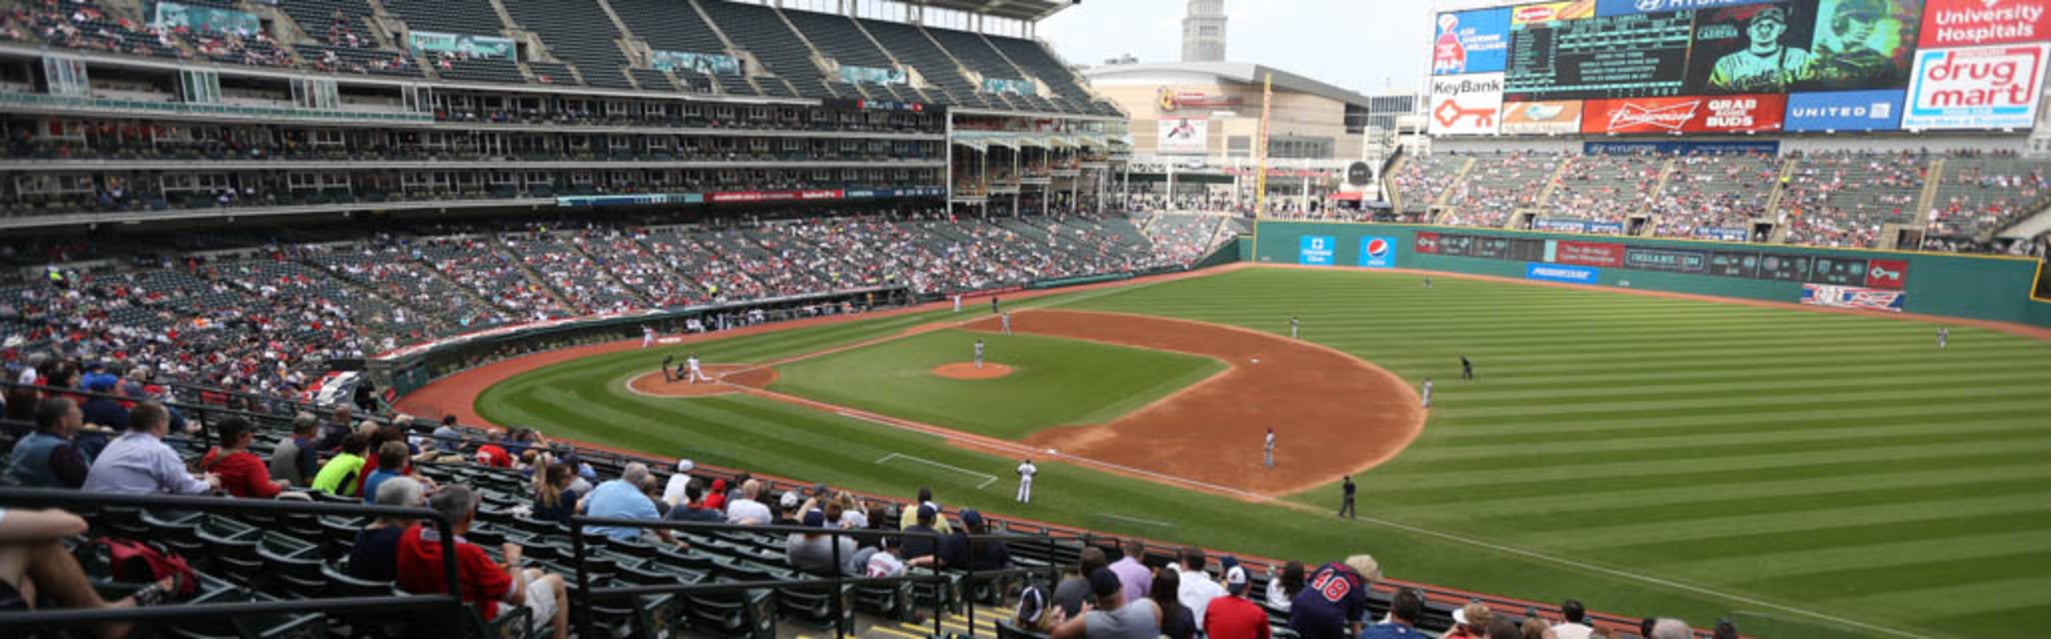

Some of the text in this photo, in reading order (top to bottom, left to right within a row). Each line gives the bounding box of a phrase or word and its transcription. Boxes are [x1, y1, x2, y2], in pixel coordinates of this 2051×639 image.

[1935, 4, 2043, 25] University
[1697, 28, 1738, 40] CABRERA
[1937, 21, 2034, 43] Hospitals
[1928, 51, 2016, 86] drug
[1434, 79, 1500, 95] KeyBank
[1930, 83, 2030, 107] mart
[1708, 99, 1757, 111] GRAB
[1792, 106, 1867, 117] UNITED
[1706, 116, 1754, 127] BUDS
